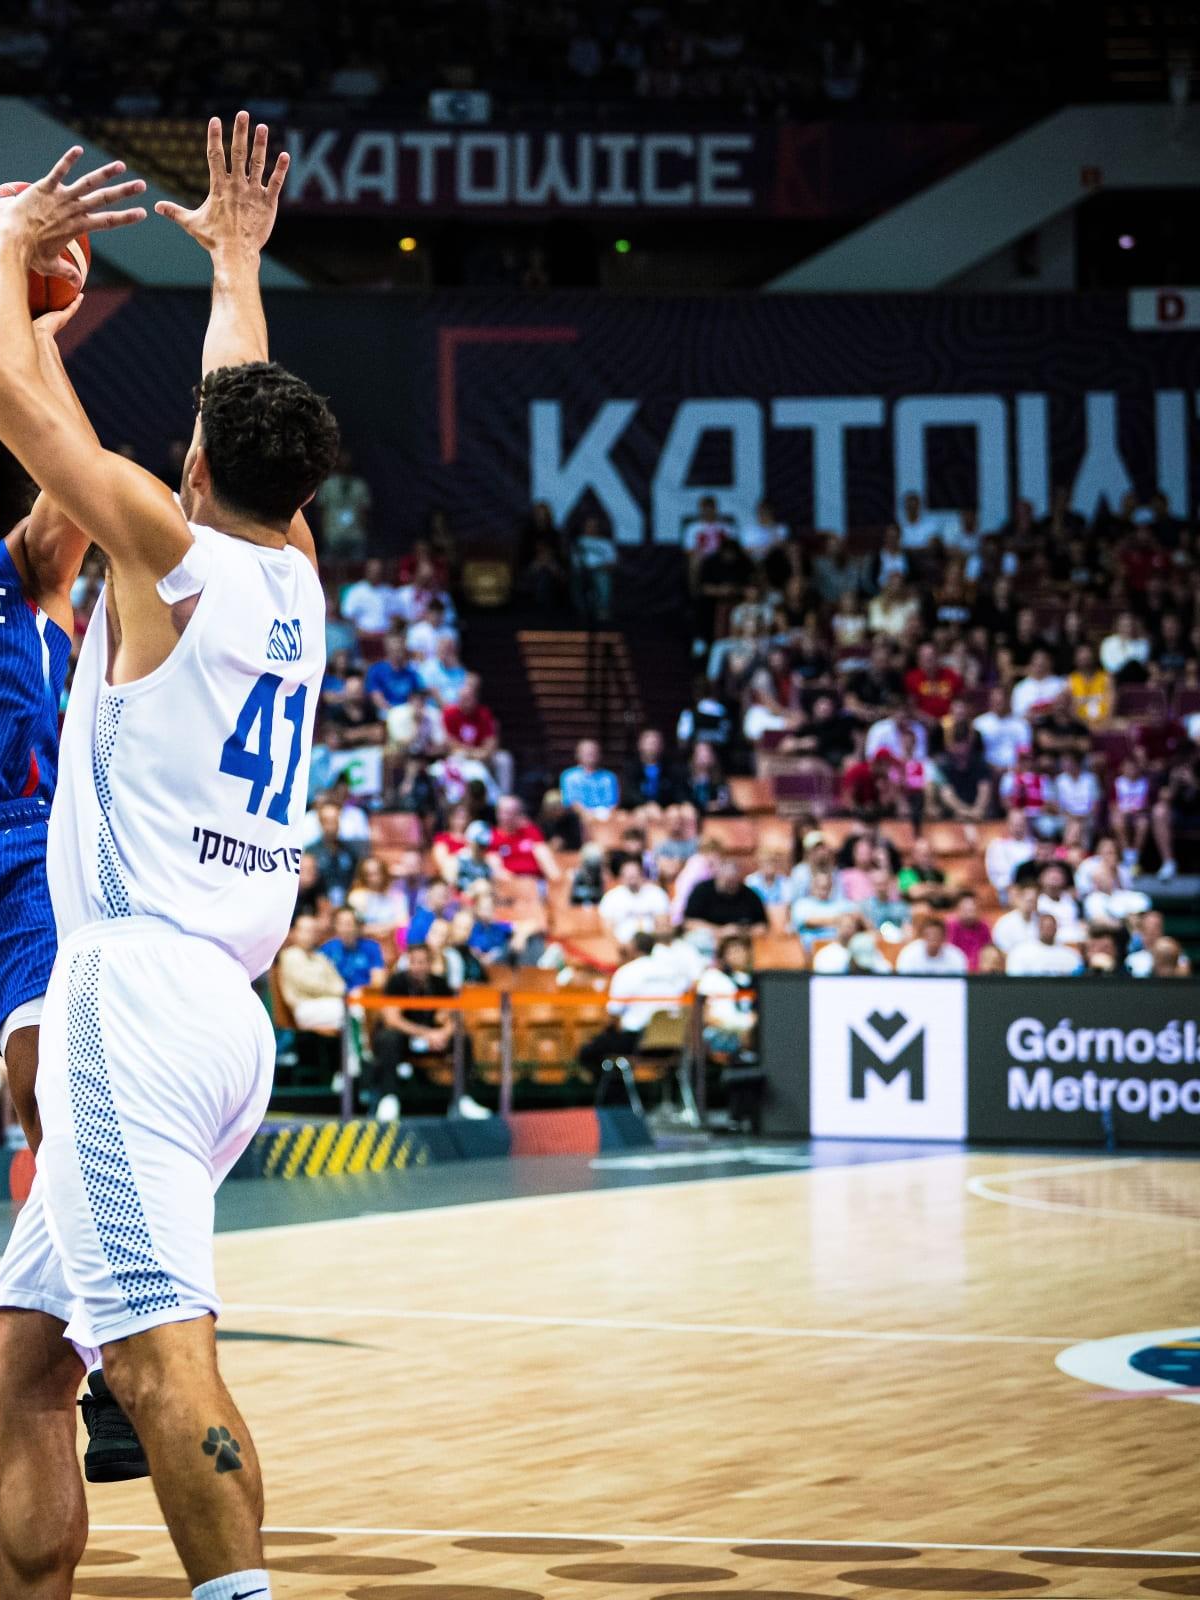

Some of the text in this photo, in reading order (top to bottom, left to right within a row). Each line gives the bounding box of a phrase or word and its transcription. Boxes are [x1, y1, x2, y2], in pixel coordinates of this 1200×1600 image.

[285, 130, 755, 206] KATOWICE
[1157, 294, 1185, 322] D
[530, 389, 1200, 546] KATOW
[218, 672, 308, 826] 41
[1006, 1017, 1200, 1064] Górnośl
[1006, 1066, 1200, 1122] Metropo
